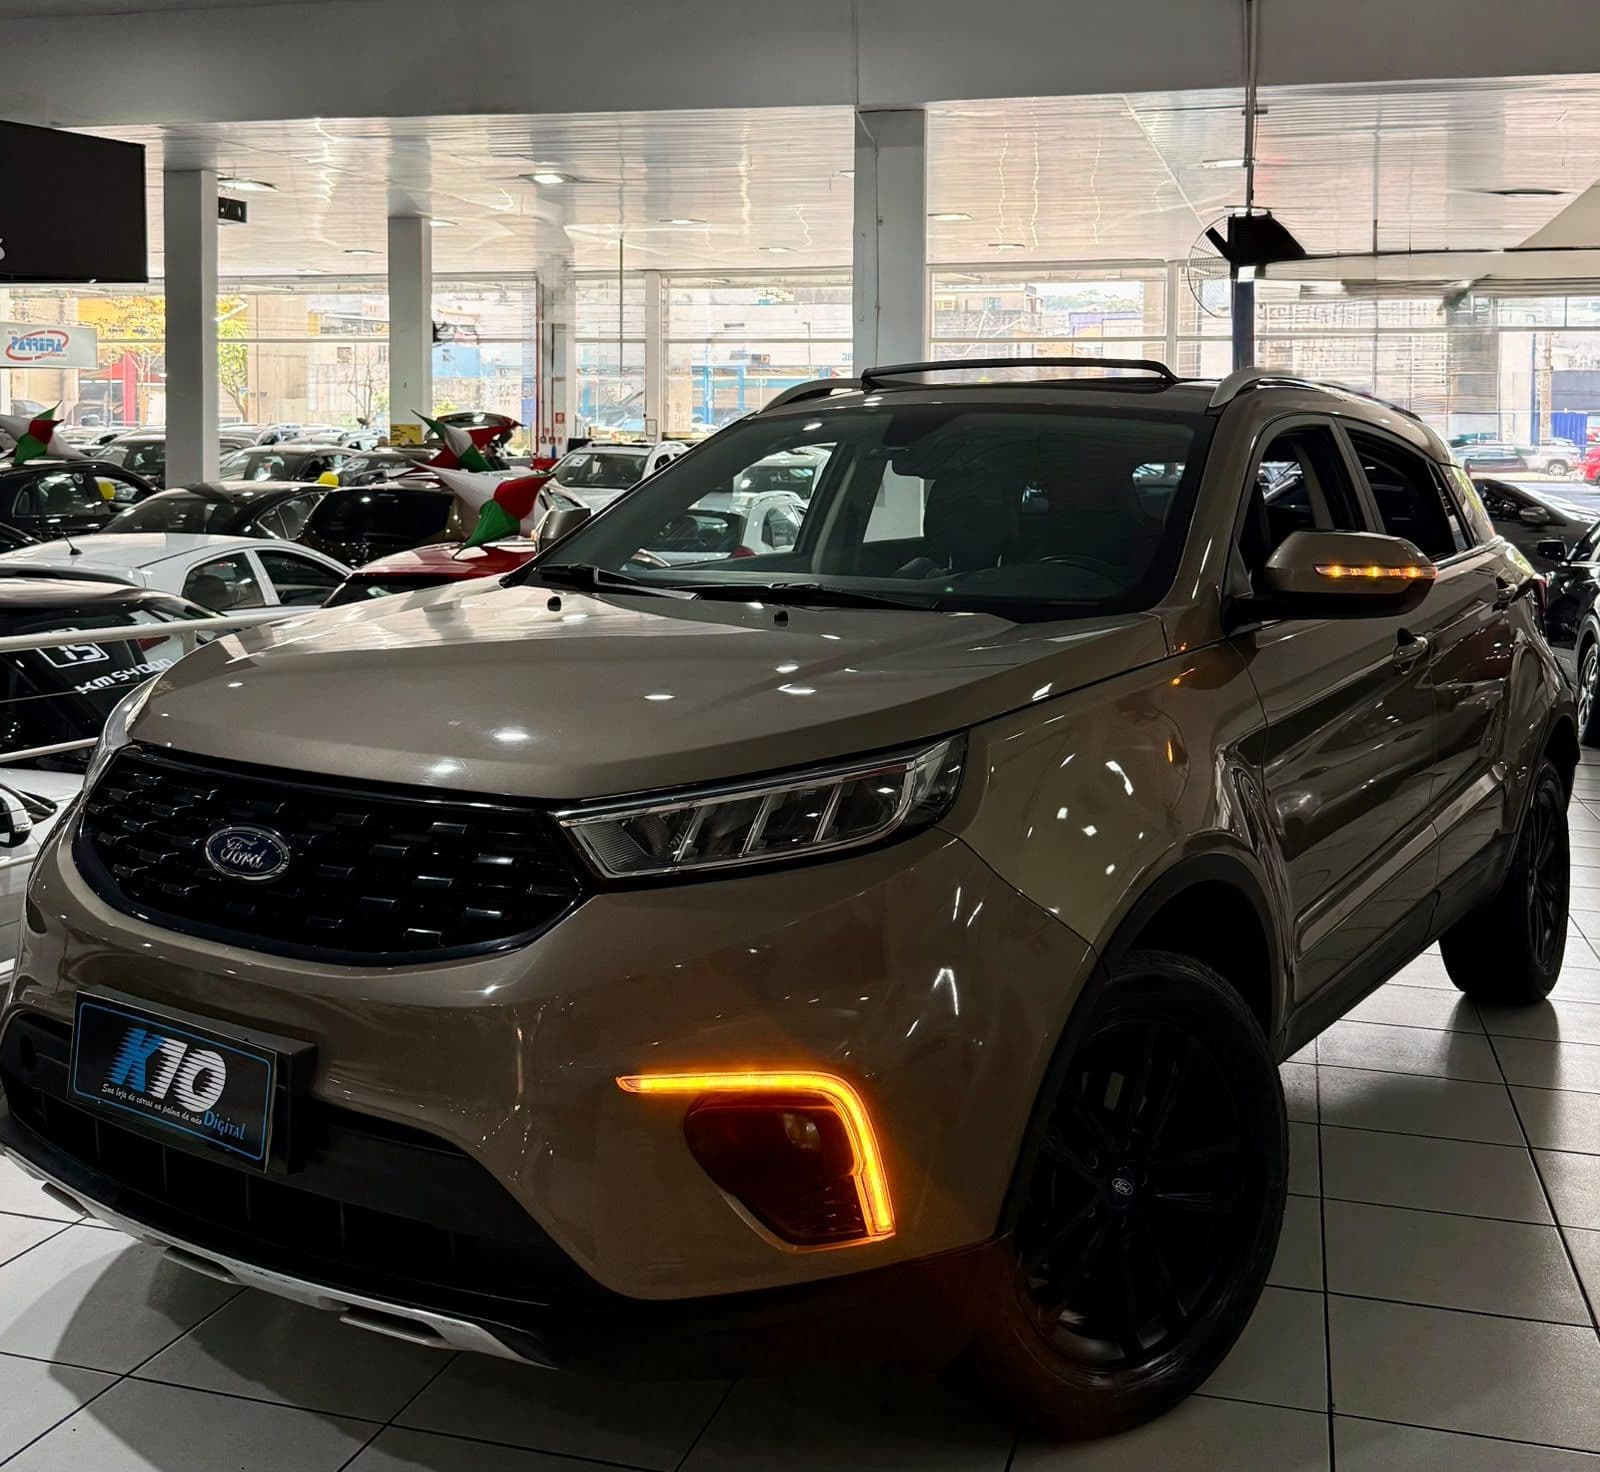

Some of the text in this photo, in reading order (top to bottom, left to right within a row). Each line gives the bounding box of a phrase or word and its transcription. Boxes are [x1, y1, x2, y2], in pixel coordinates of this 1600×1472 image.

[220, 836, 266, 869] Ford
[104, 1026, 227, 1113] K10
[101, 1083, 115, 1095] Sua
[115, 1087, 127, 1100] loja
[128, 1092, 136, 1102] de
